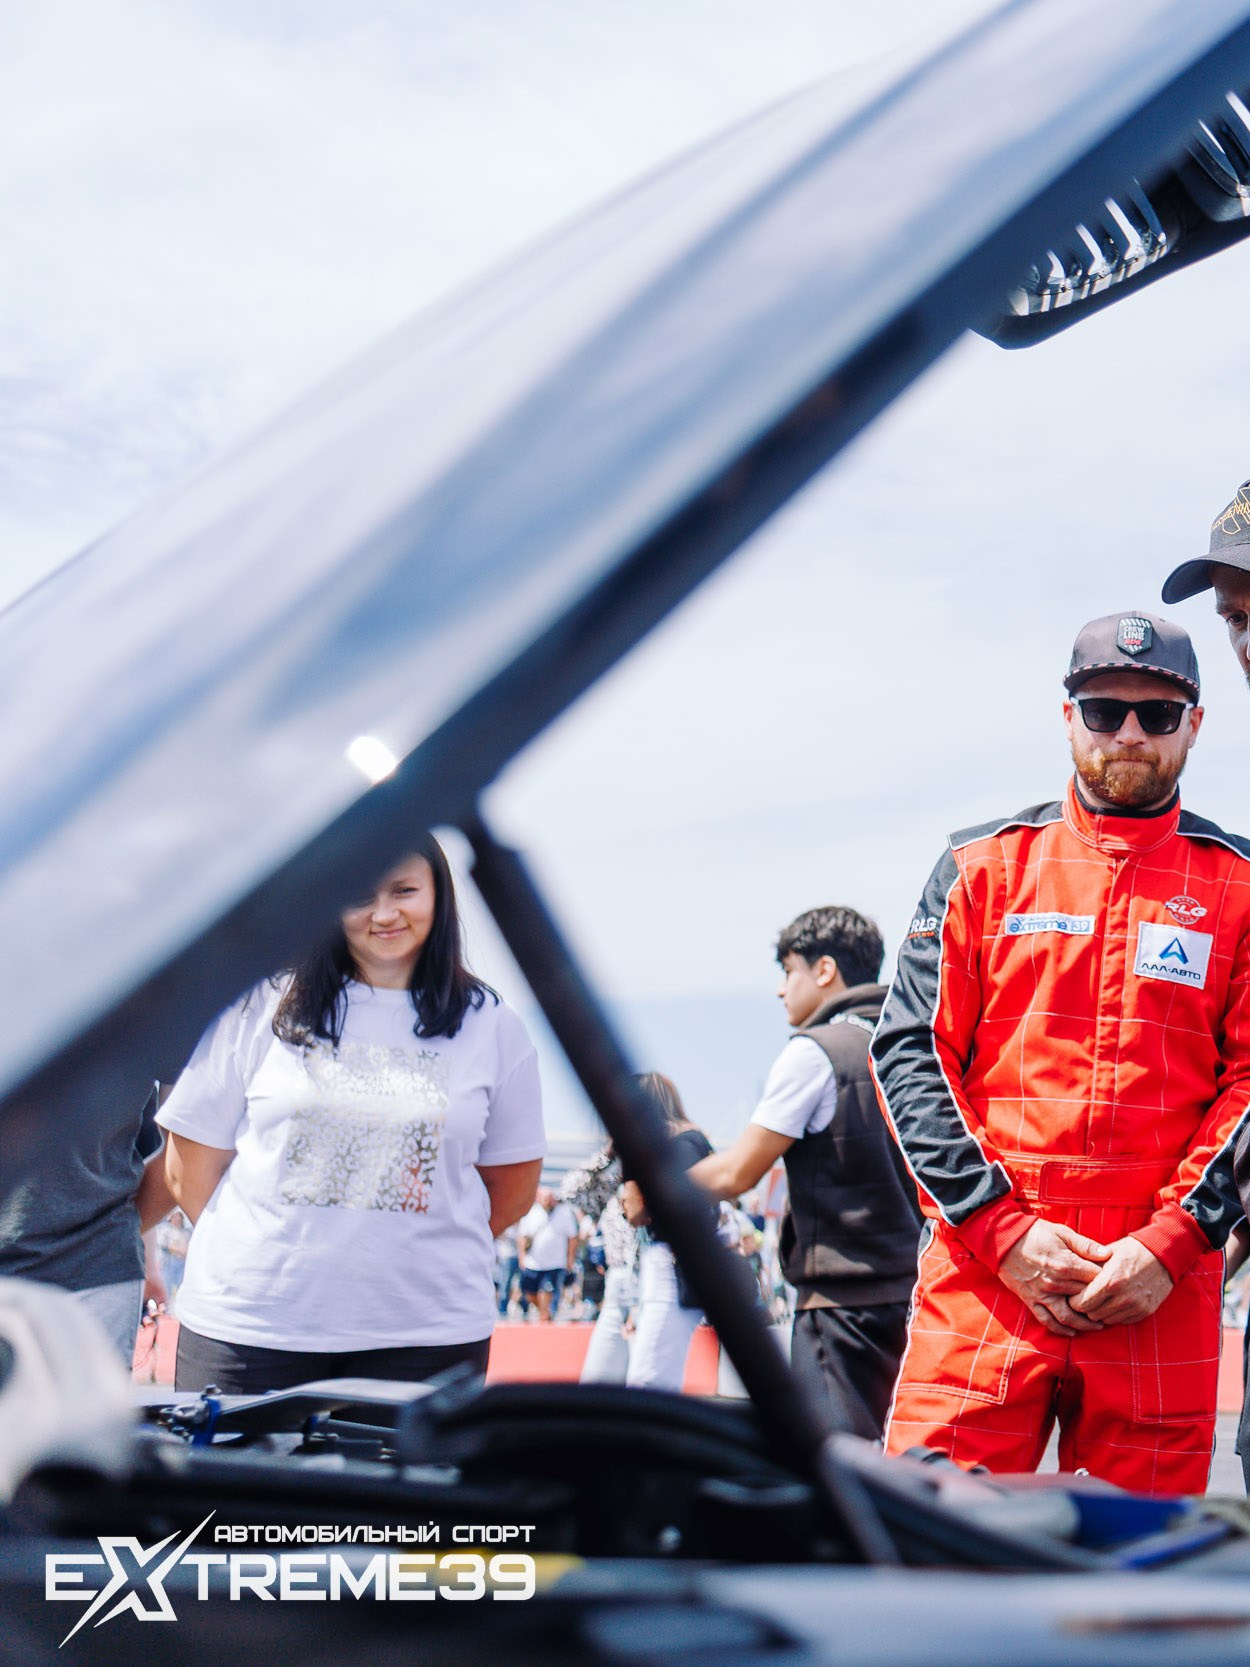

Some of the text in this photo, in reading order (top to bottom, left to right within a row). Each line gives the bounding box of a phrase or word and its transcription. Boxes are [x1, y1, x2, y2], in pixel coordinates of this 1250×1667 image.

[1165, 901, 1208, 918] RLG
[910, 916, 938, 933] RLG
[1072, 920, 1089, 932] 39
